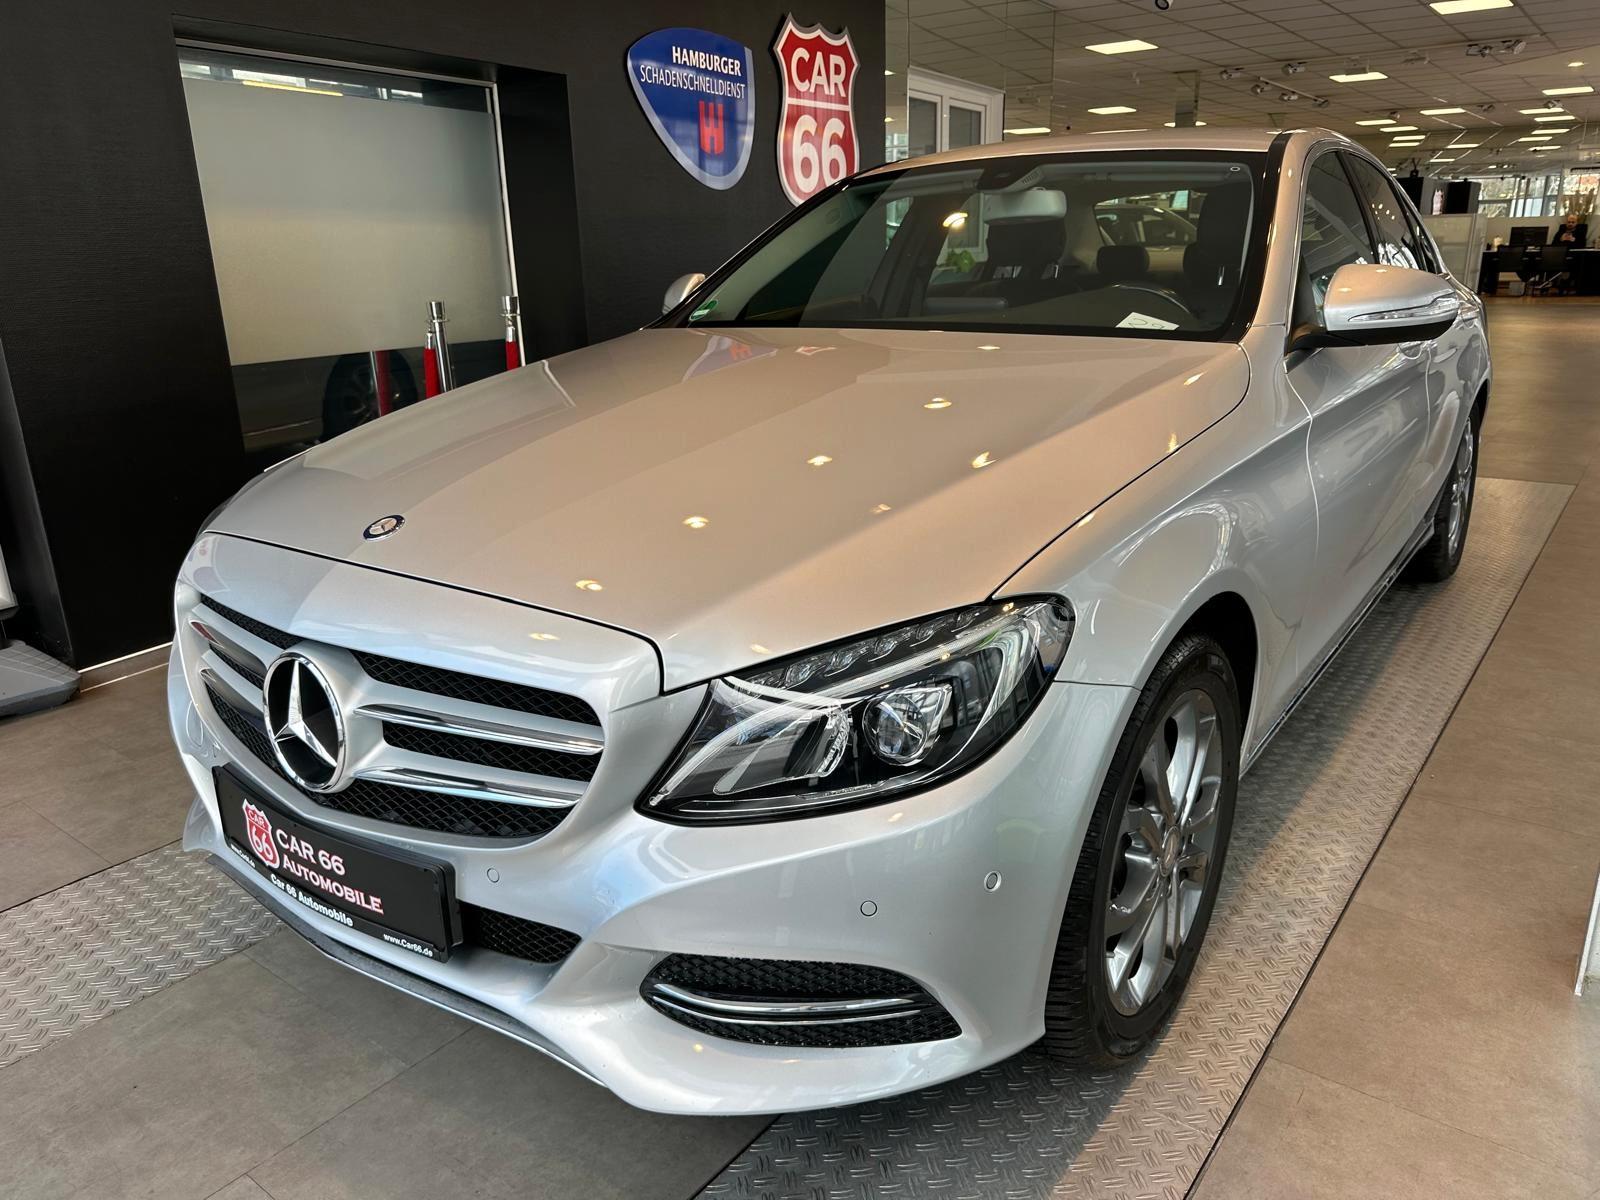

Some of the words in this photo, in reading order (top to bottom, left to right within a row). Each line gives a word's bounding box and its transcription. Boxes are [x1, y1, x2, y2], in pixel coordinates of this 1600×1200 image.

[671, 46, 742, 76] HAMBURGER
[791, 47, 847, 97] CAR
[640, 65, 746, 99] SCHADENSCHNELLDIENST
[792, 114, 848, 194] 66
[248, 810, 266, 828] CAR
[252, 826, 274, 861] 66
[276, 829, 317, 864] CAR
[318, 849, 346, 876] 66
[270, 873, 285, 890] Car
[286, 884, 298, 899] 66
[298, 891, 354, 927] Automobile
[282, 854, 384, 914] AUTOMOBILE
[383, 933, 433, 957] www.Car66.de
